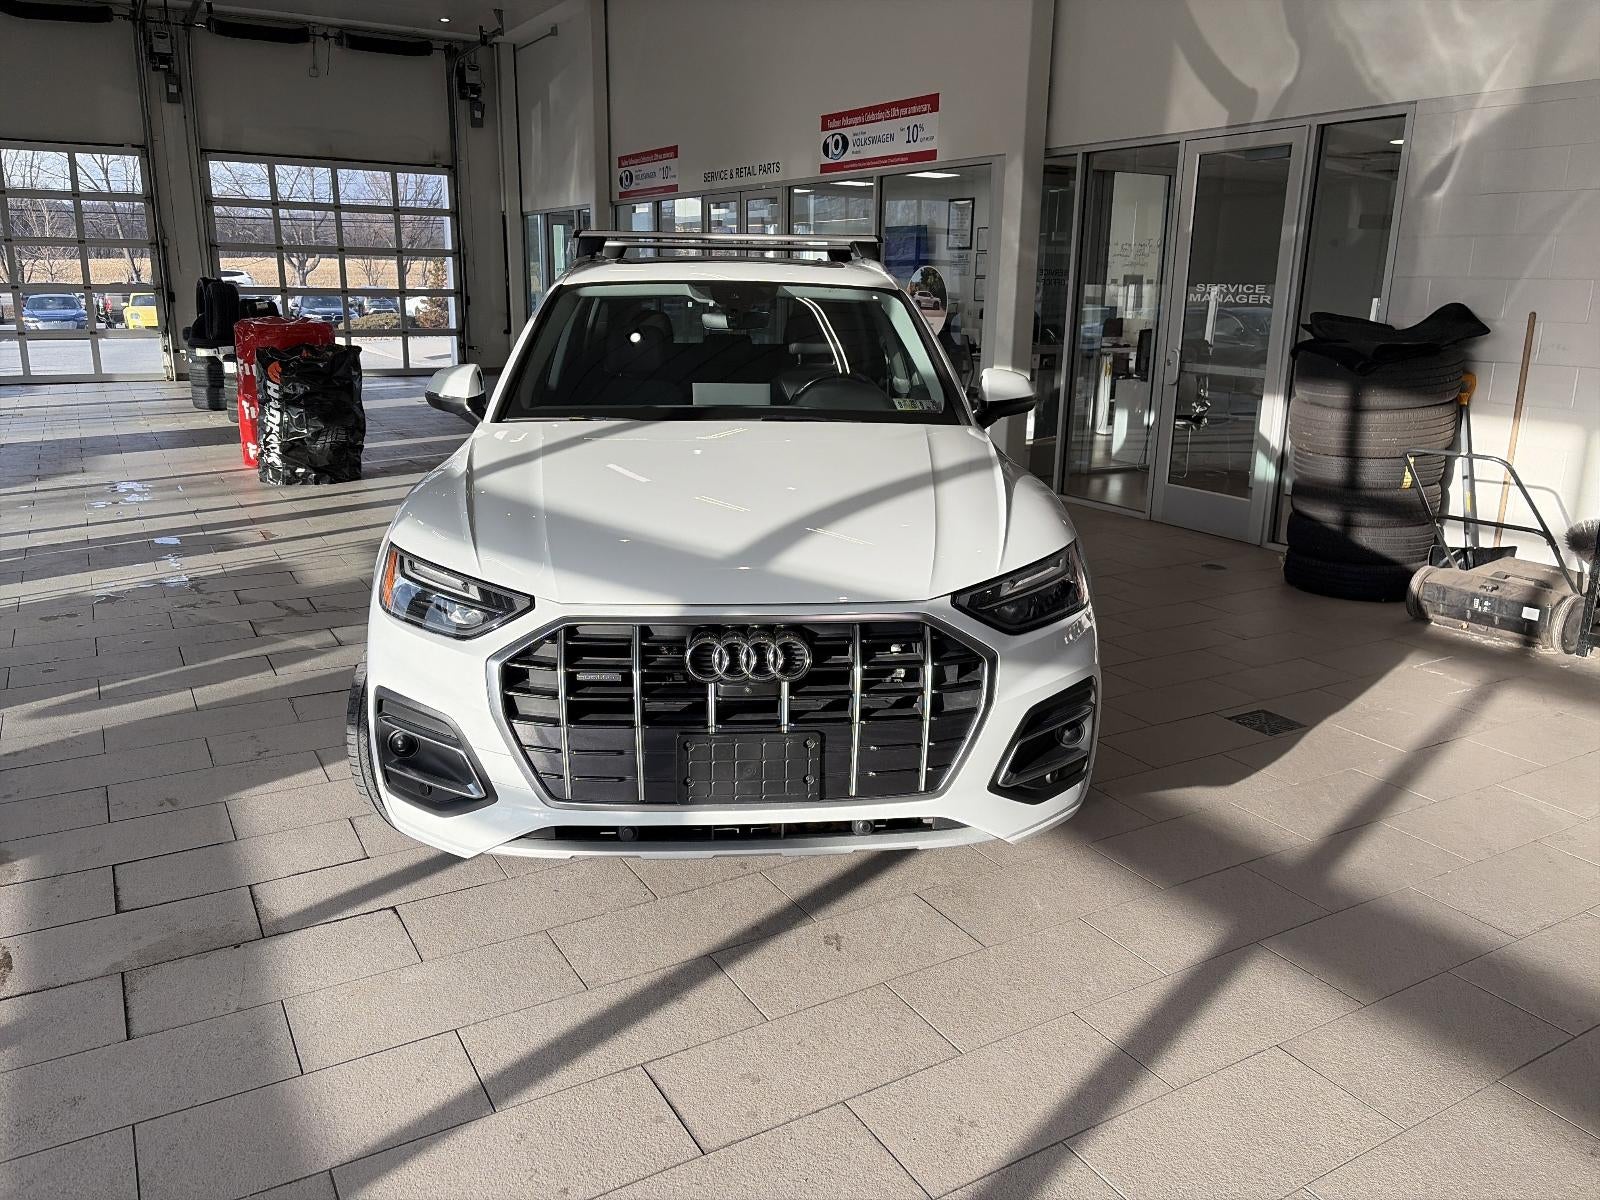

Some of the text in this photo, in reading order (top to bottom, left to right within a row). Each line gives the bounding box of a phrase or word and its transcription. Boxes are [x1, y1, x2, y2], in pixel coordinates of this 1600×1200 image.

[852, 133, 895, 147] VOLKSWAGEN
[704, 161, 780, 183] SERVICE & RETAIL PARTS
[1196, 283, 1266, 293] SERVICE
[1190, 294, 1271, 304] MANAGER
